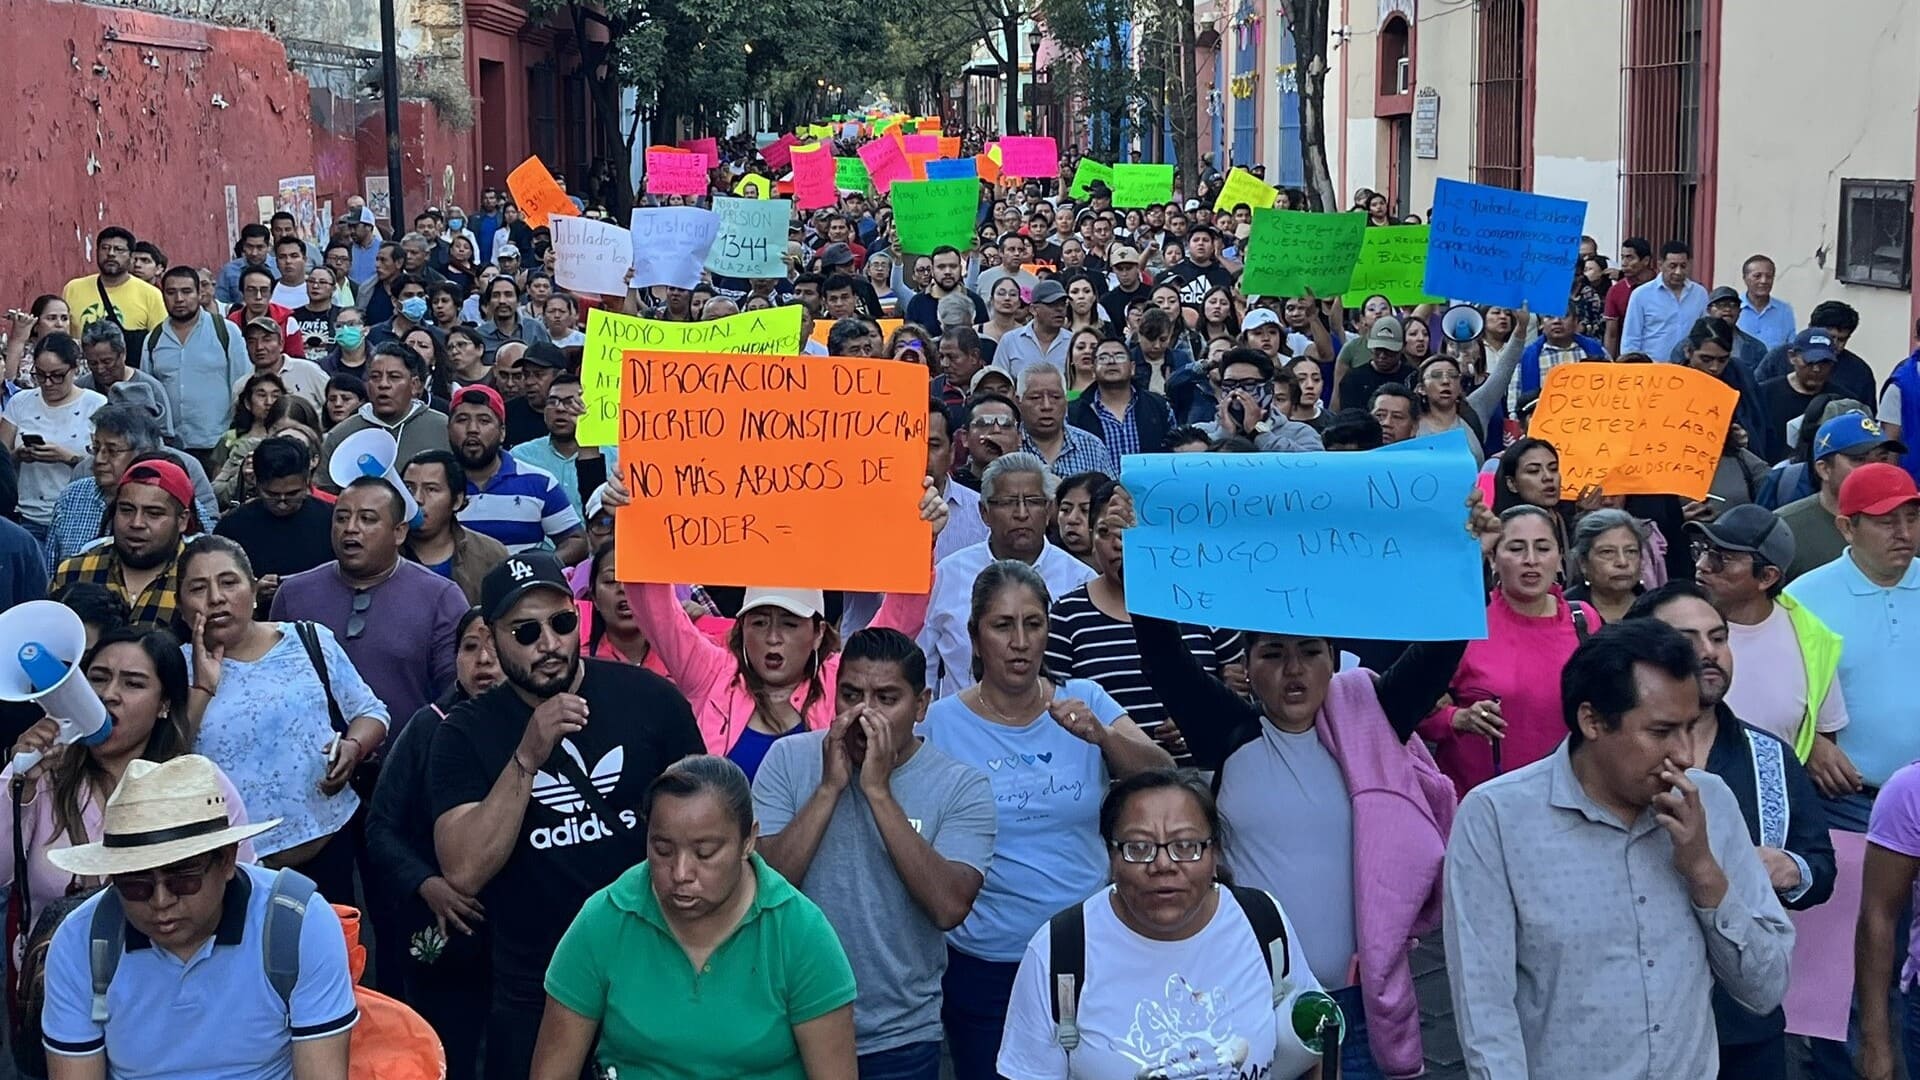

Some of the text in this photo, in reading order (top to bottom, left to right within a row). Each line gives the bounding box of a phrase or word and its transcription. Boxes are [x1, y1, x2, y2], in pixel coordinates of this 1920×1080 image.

[1436, 221, 1446, 233] a
[1453, 217, 1471, 238] los
[612, 248, 628, 264] los
[720, 234, 766, 263] 1344
[714, 257, 762, 274] PLAZAS
[598, 316, 766, 346] APOYO TOTAL A
[629, 356, 892, 399] DEROGACIÓN DEL
[1551, 368, 1685, 391] GOBIERNO
[1549, 393, 1721, 420] DEVUELVE LA
[621, 407, 726, 443] DECRETO
[1539, 416, 1648, 436] CERTEZA
[1595, 442, 1610, 458] A
[1628, 442, 1668, 458] LAS
[629, 456, 895, 499] NO MÁS ABUSOS DE
[1566, 465, 1608, 481] NAS
[1140, 470, 1440, 535] Gobierno NO
[664, 514, 770, 550] PODER
[1298, 527, 1403, 561] NADA
[506, 558, 534, 581] LA
[1172, 583, 1317, 620] DE TI
[1041, 774, 1084, 802] day
